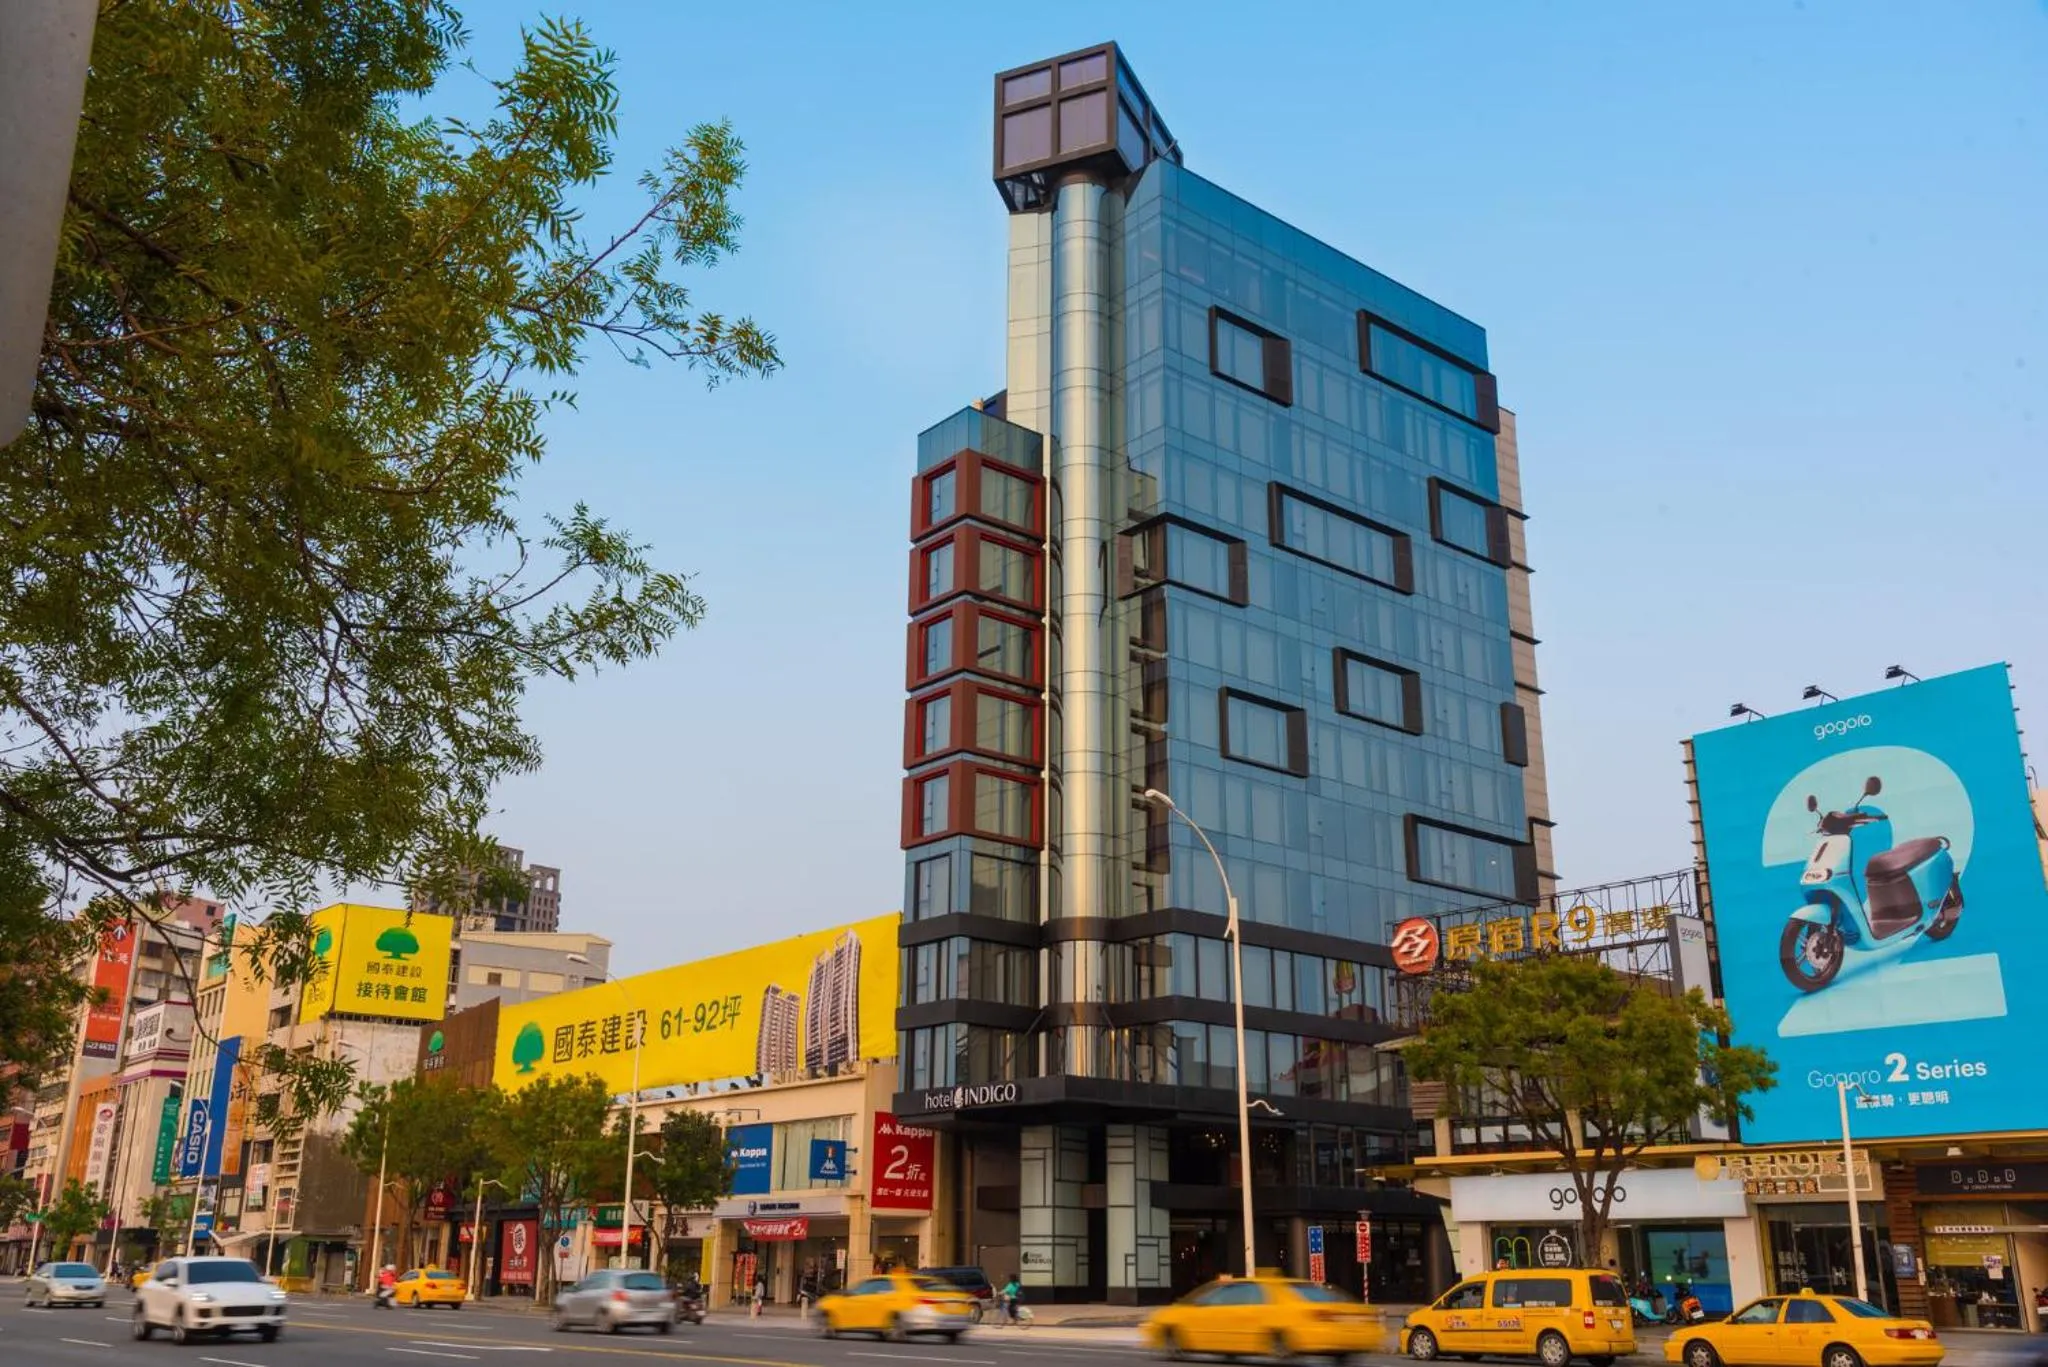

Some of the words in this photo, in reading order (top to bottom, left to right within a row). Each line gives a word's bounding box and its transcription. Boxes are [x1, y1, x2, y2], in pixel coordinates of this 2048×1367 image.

[1814, 714, 1871, 741] gogoro
[366, 961, 422, 979] 國泰建設
[356, 981, 429, 1004] 接待會館
[552, 1009, 648, 1064] 國泰建設
[660, 995, 743, 1041] 61-92坪
[1884, 1052, 1910, 1083] 2
[1916, 1059, 1988, 1081] Series
[924, 1090, 954, 1110] hotel
[964, 1083, 1017, 1106] INDIGO
[187, 1110, 207, 1165] CASIO
[895, 1124, 933, 1139] Kappa
[739, 1147, 767, 1158] Kappa
[1549, 1186, 1627, 1211] gooo
